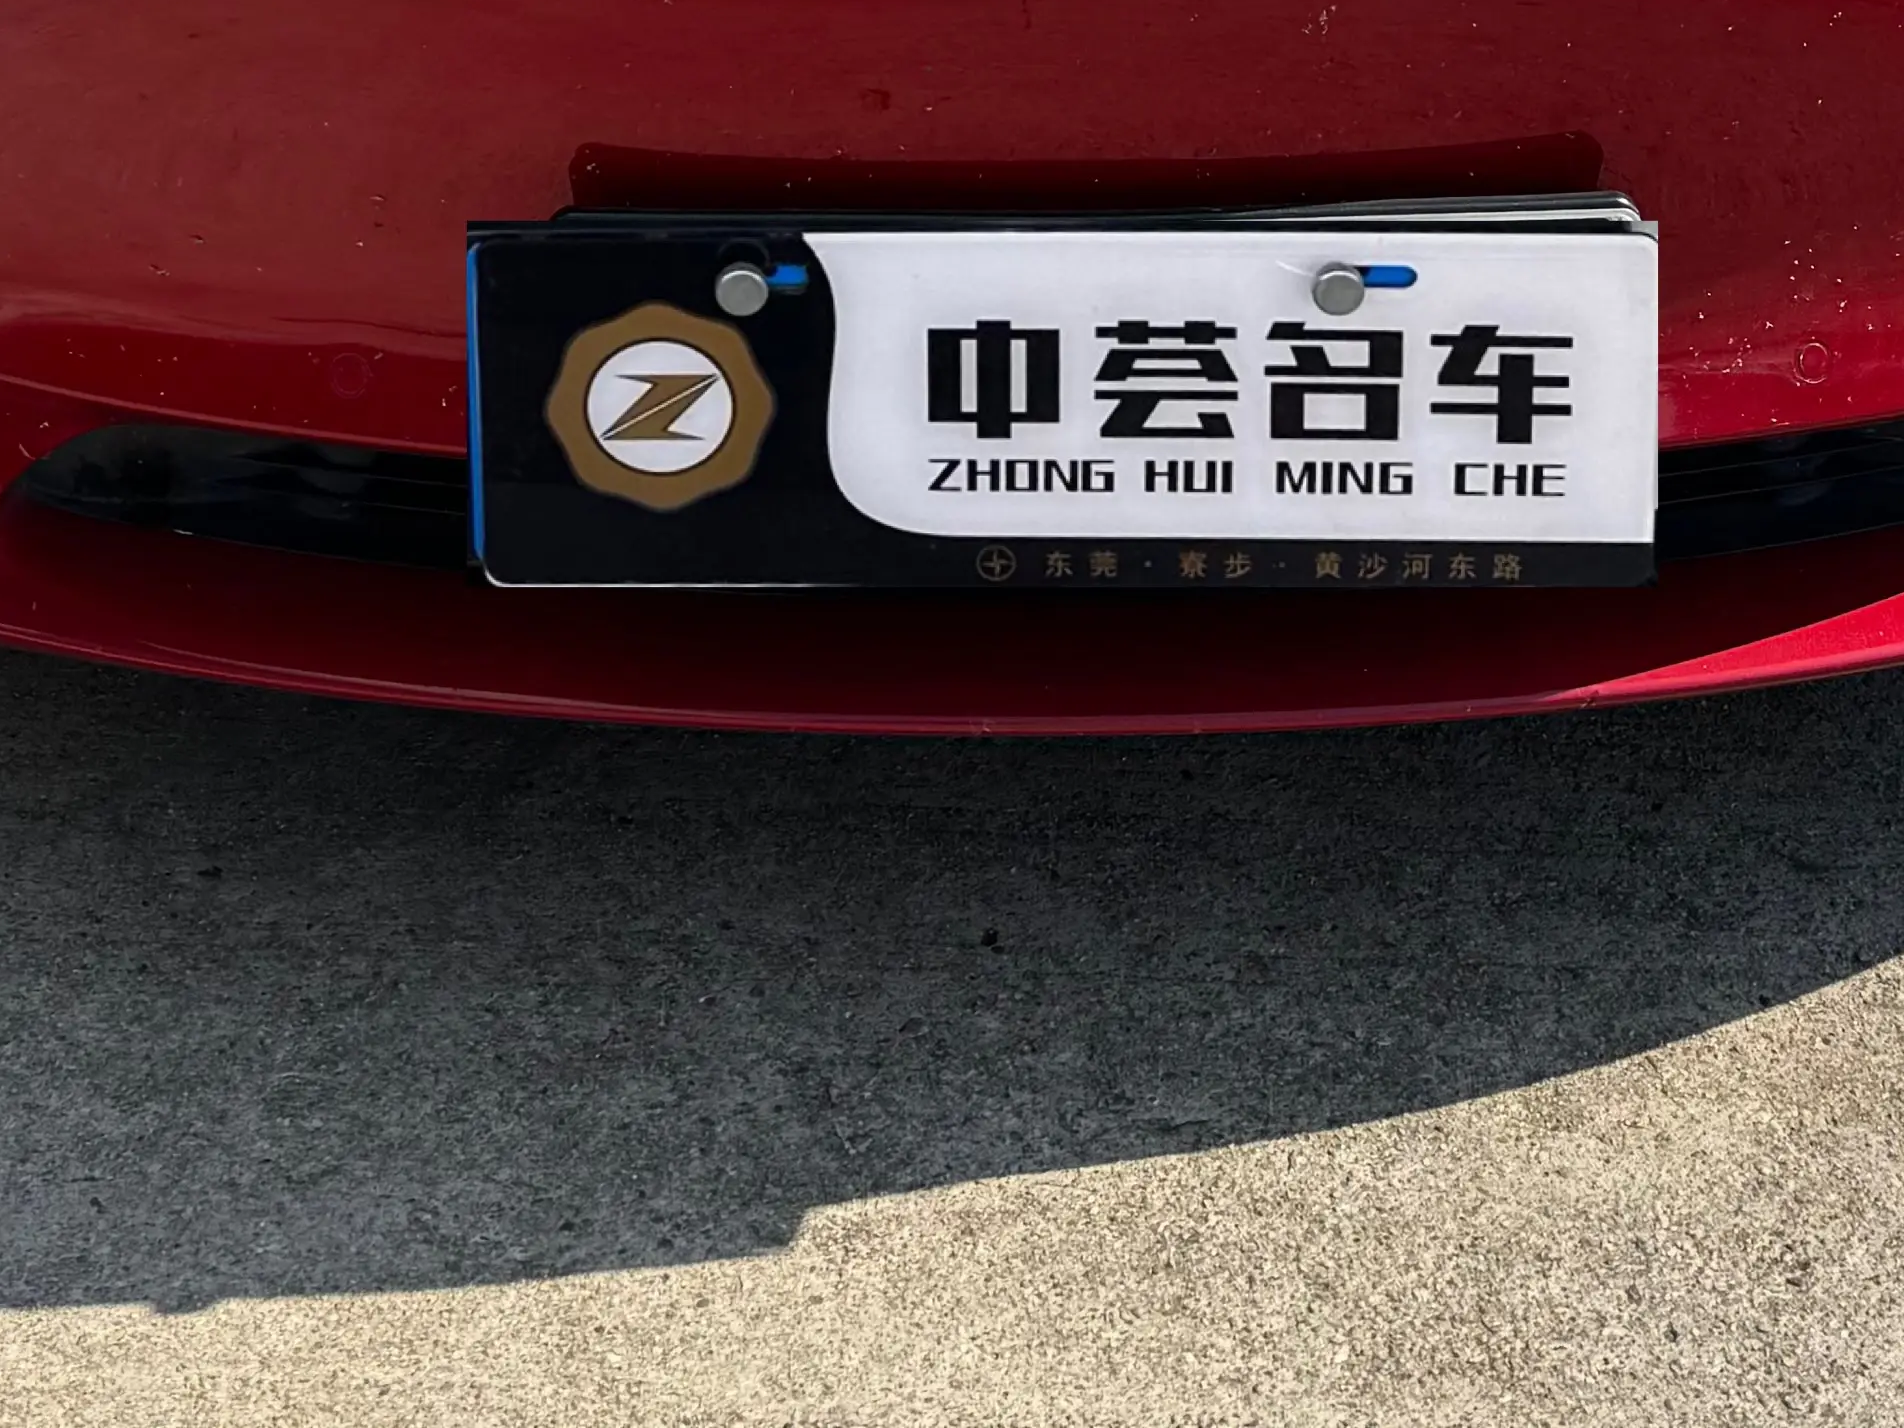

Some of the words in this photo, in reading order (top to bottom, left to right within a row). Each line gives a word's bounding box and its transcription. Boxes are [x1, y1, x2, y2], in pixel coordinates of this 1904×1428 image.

[927, 319, 1574, 445] 中荟名车
[928, 458, 1115, 493] ZHONG
[1144, 460, 1233, 494] HUI
[1276, 461, 1413, 495] MING
[1453, 463, 1565, 497] CHE
